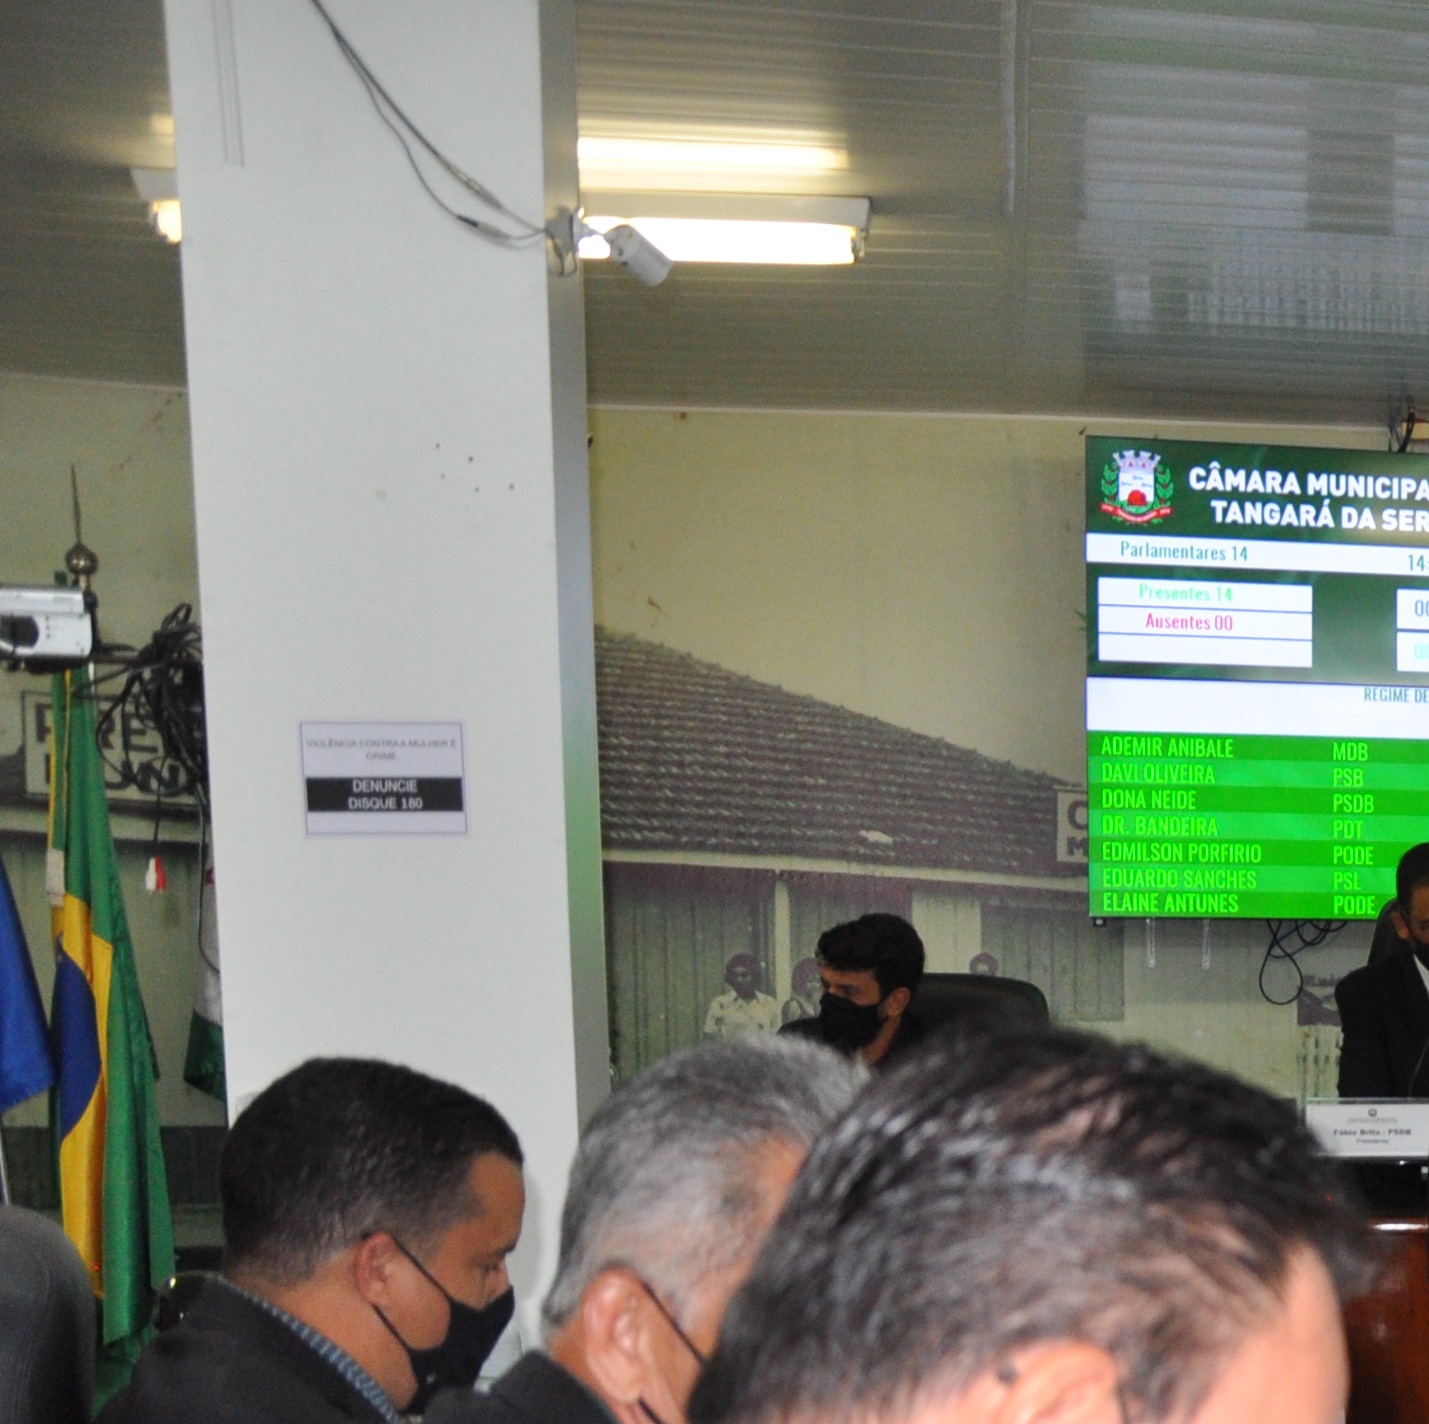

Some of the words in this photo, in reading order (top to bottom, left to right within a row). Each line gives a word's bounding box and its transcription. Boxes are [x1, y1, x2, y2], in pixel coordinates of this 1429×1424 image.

[1189, 461, 1301, 496] CÂMARA
[1210, 498, 1335, 528] TANGARÁ
[1341, 507, 1377, 531] DA
[1120, 540, 1227, 562] Parlamentares
[1231, 545, 1248, 562] 14
[1139, 582, 1211, 602] Presentes
[1216, 586, 1233, 603] 14
[1145, 611, 1211, 631] Ausentes
[1214, 614, 1233, 632] 00
[1364, 687, 1412, 704] REGIME
[1414, 688, 1429, 704] DE
[1101, 736, 1163, 757] ADEMIR
[1167, 737, 1234, 758] ANIBALE
[1332, 741, 1369, 762] MDB
[1101, 763, 1140, 783] DAVI
[1143, 763, 1215, 784] OLIVEIRA
[1332, 767, 1364, 787] PSB
[352, 779, 418, 793] DENUNCIE
[348, 797, 397, 809] DISQUE
[401, 797, 423, 809] 180
[1101, 788, 1146, 809] DONA
[1151, 789, 1196, 810] NEIDE
[1332, 793, 1375, 813] PSDB
[1101, 814, 1131, 835] DR.
[1135, 815, 1218, 836] BANDEIRA
[1332, 819, 1364, 839] PDT
[1102, 841, 1183, 862] EDMILSON
[1188, 842, 1262, 863] PORFIRIO
[1332, 845, 1374, 865] PODE
[1102, 867, 1179, 888] EDUARDO
[1183, 869, 1257, 889] SANCHES
[1332, 870, 1362, 891] PSL
[1102, 892, 1159, 912] ELAINE
[1163, 892, 1239, 913] ANTUNES
[1332, 894, 1376, 915] PODE
[1388, 1128, 1412, 1136] PSDB
